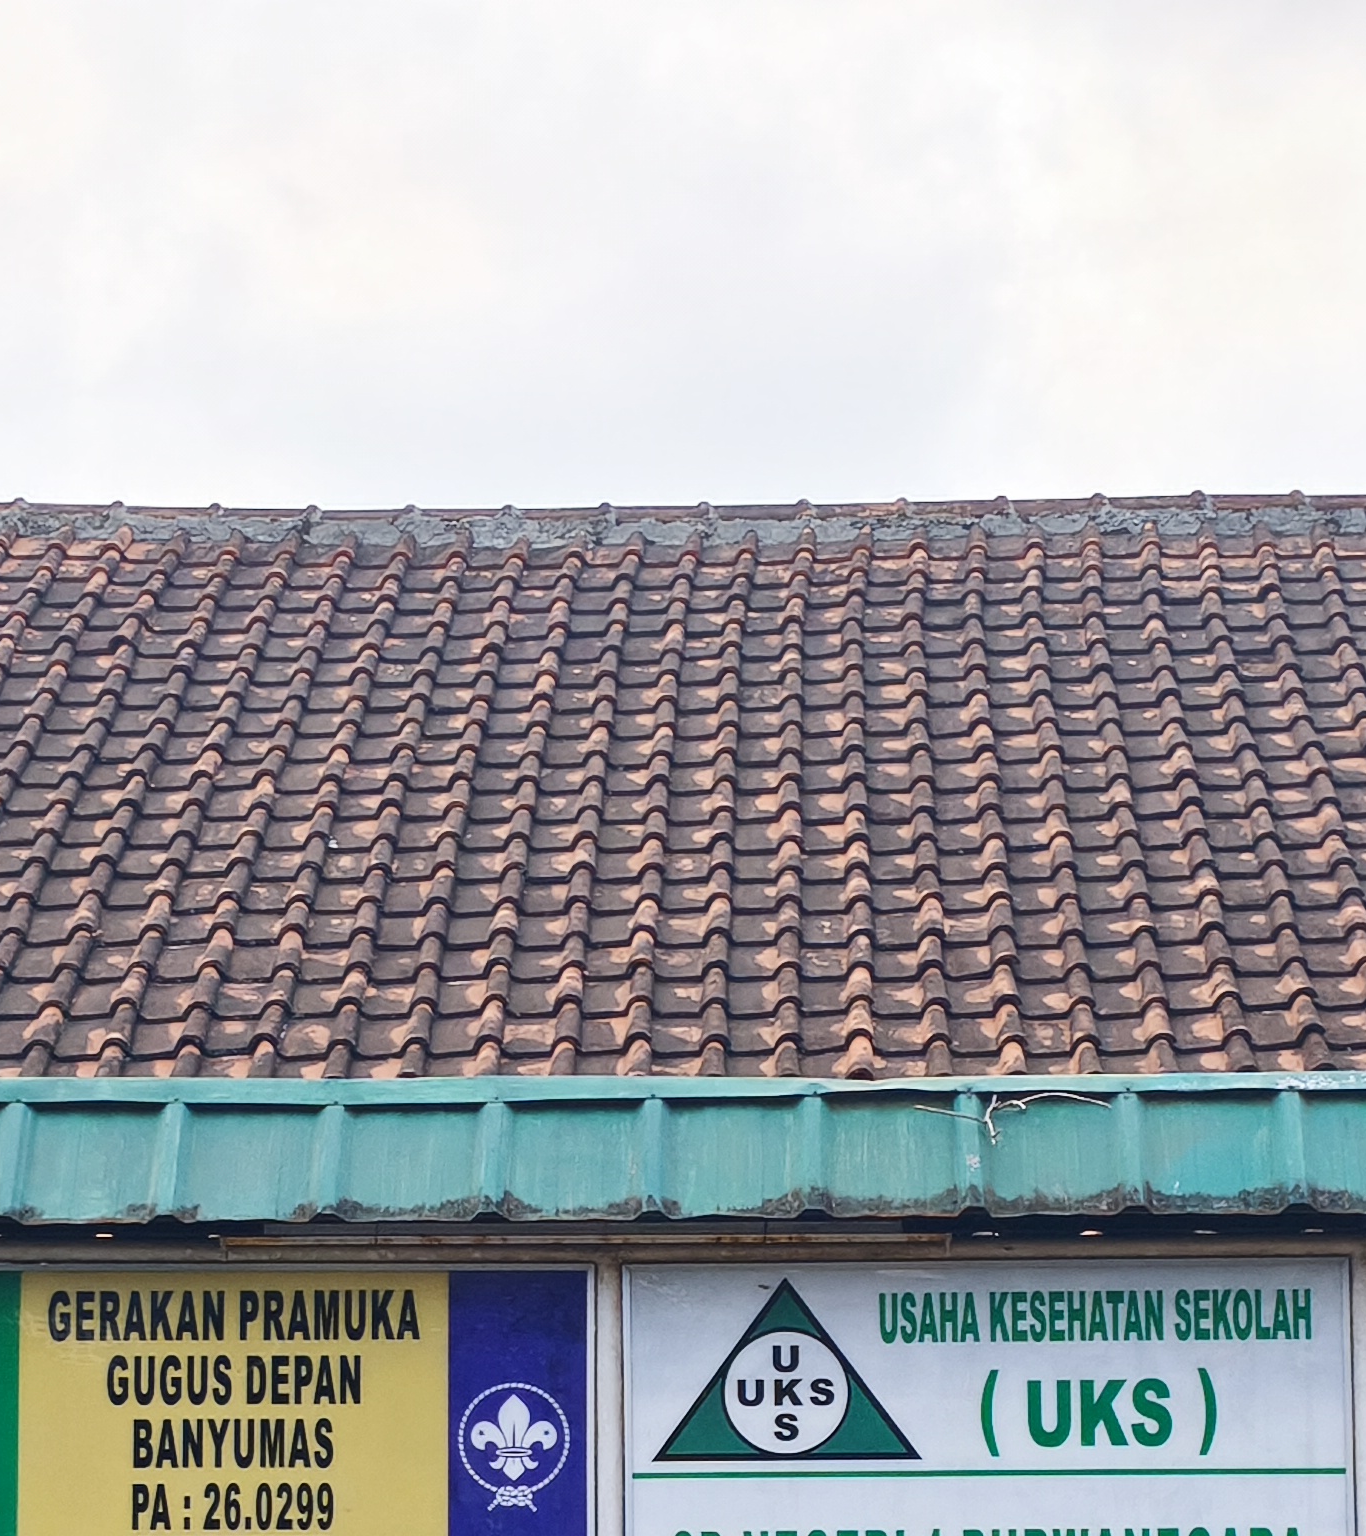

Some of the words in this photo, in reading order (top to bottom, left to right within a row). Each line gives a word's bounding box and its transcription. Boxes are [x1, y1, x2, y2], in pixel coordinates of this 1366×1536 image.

[48, 1290, 225, 1341] GERAKAN
[240, 1289, 420, 1340] PRAMUKA
[879, 1292, 980, 1343] USAHA
[989, 1290, 1163, 1342] KESEHATAN
[1175, 1288, 1311, 1341] SEKOLAH
[107, 1355, 231, 1405] GUGUS
[247, 1355, 361, 1404] DEPAN
[737, 1379, 834, 1406] UKS
[1027, 1378, 1172, 1447] UKS
[133, 1418, 333, 1468] BANYUMAS
[132, 1484, 171, 1530] PA
[203, 1483, 333, 1530] 26.0299
